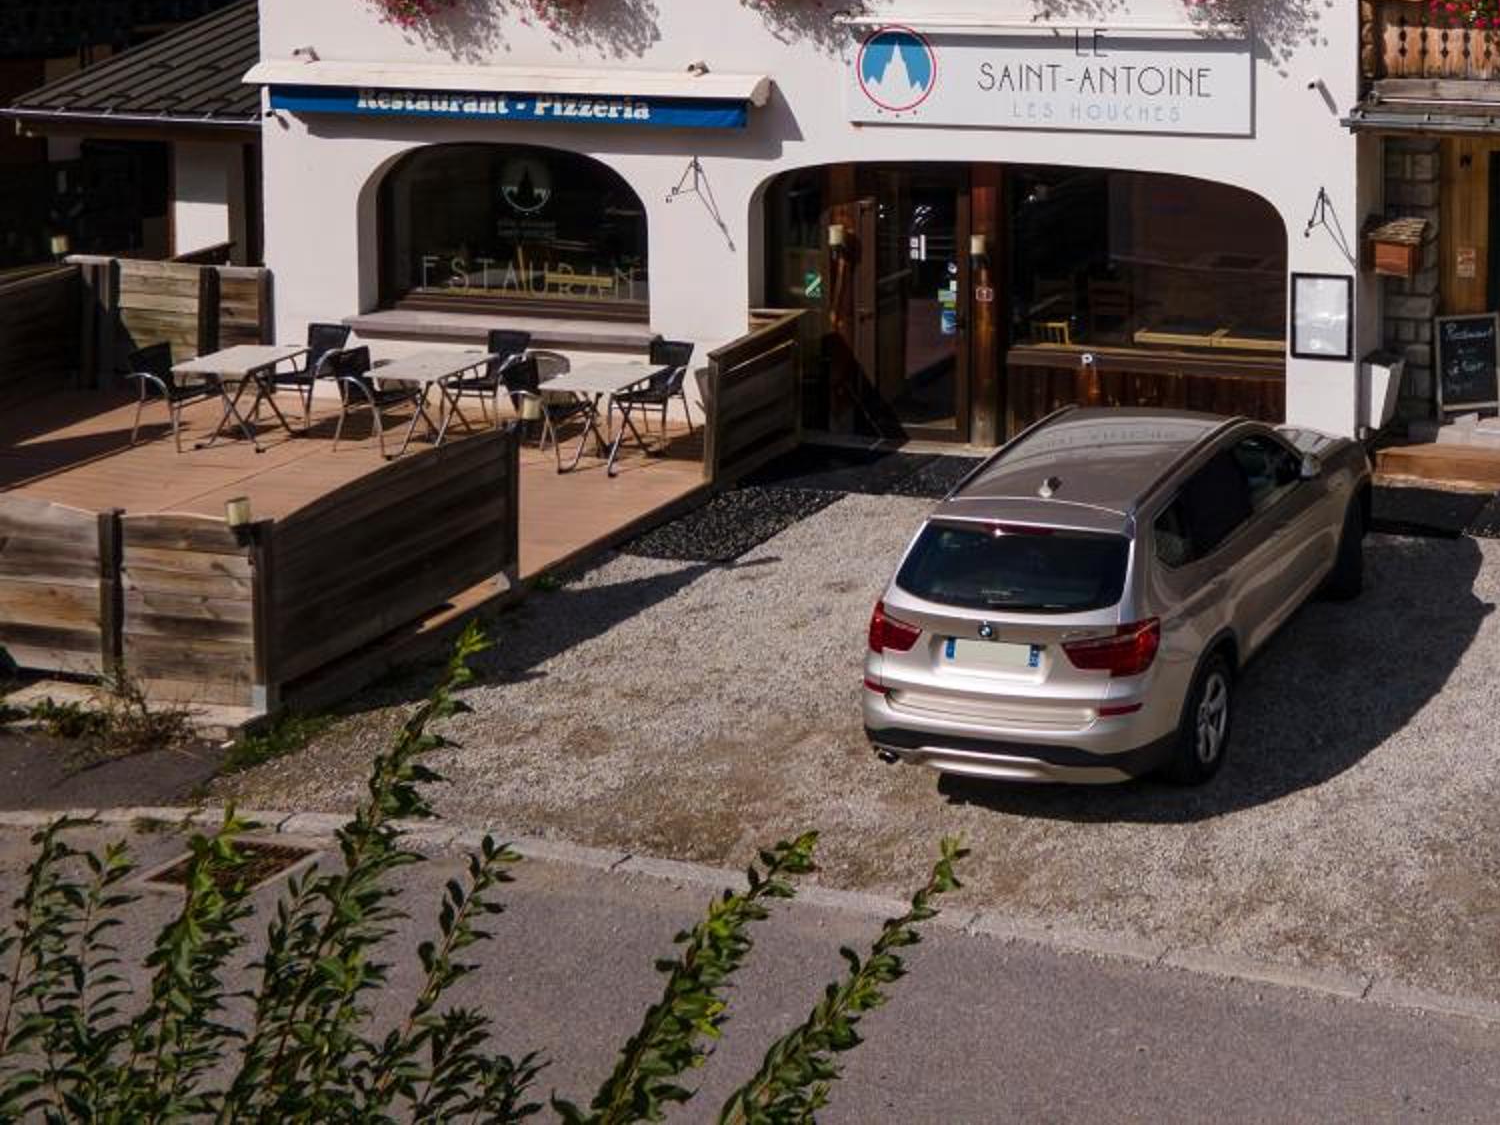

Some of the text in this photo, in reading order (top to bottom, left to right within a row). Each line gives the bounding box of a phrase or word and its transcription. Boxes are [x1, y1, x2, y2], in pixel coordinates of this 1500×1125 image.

[1074, 27, 1110, 58] LE
[976, 62, 1213, 98] SAINT-ANTOINE
[356, 88, 510, 115] Restaurant
[534, 94, 651, 120] Pizzeria
[1012, 101, 1182, 123] LES HOUCHES
